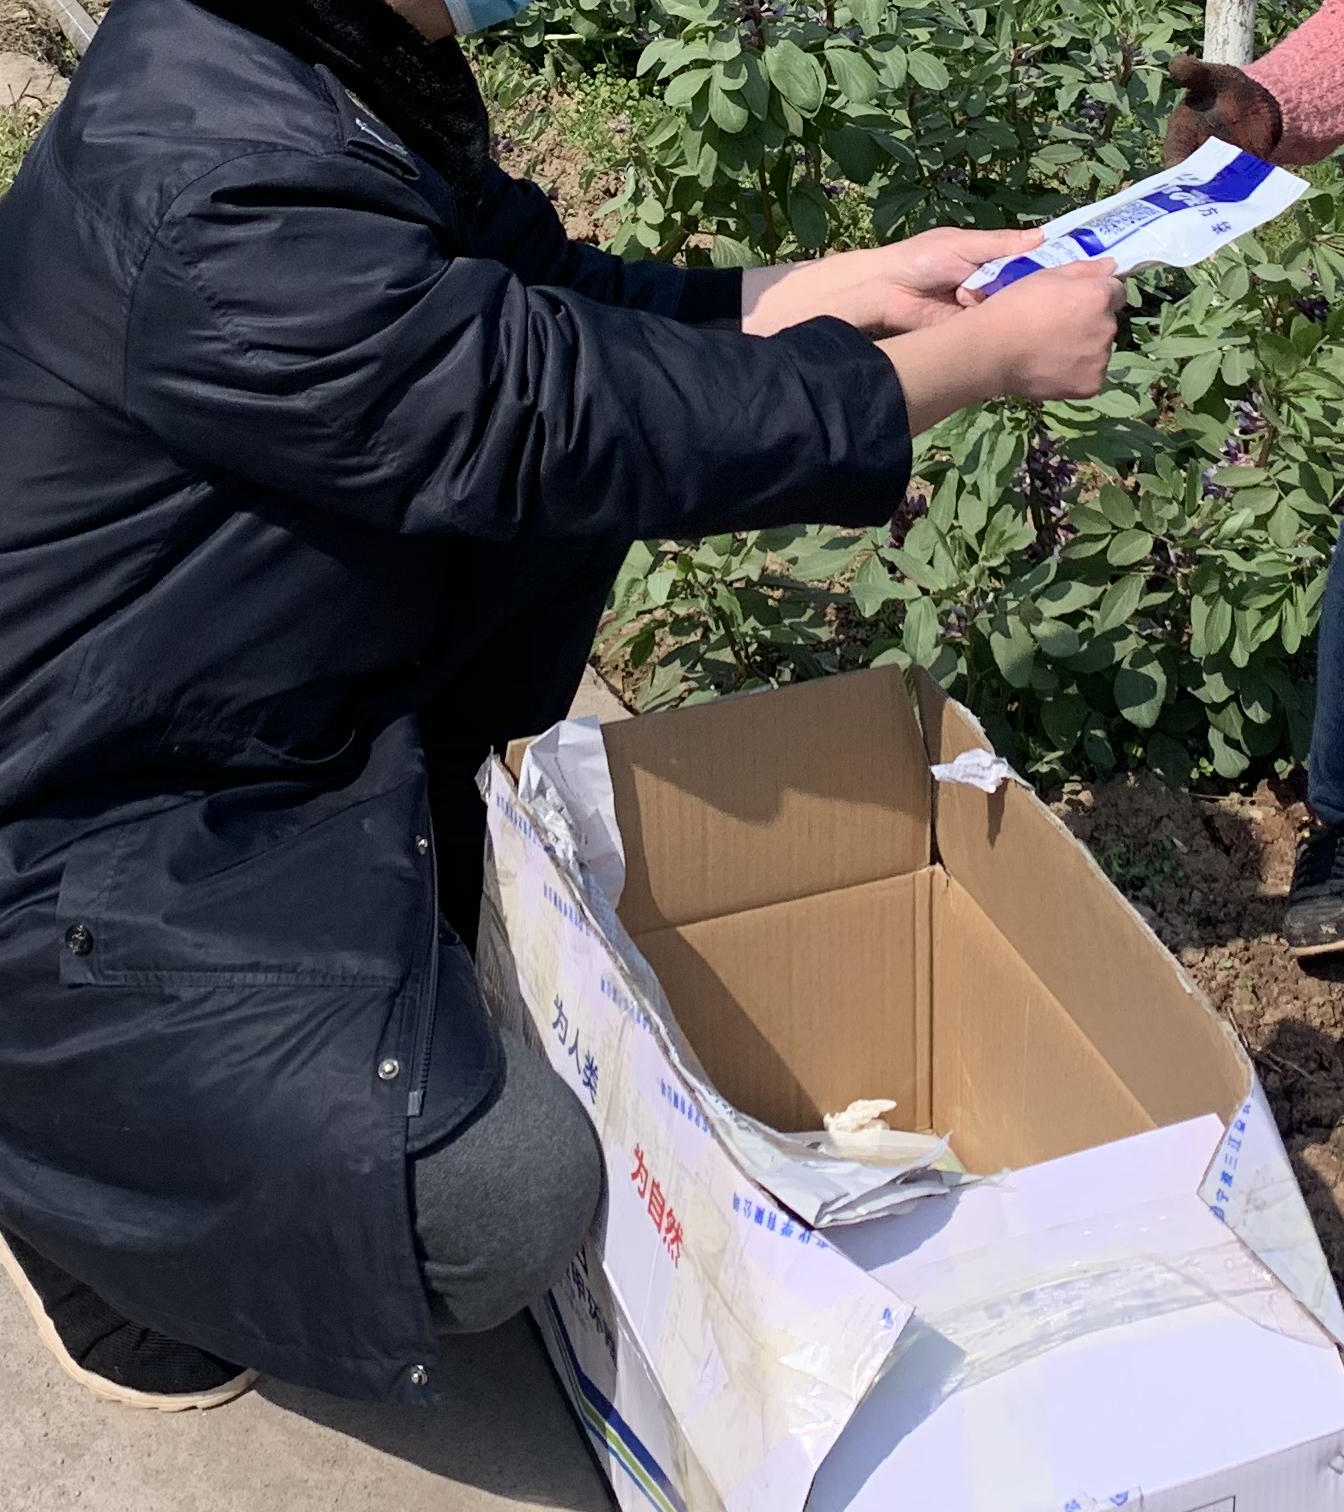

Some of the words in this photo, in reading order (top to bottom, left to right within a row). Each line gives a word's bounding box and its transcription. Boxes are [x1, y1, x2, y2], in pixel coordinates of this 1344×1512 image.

[552, 994, 599, 1105] 为人类
[631, 1143, 683, 1269] 为自然
